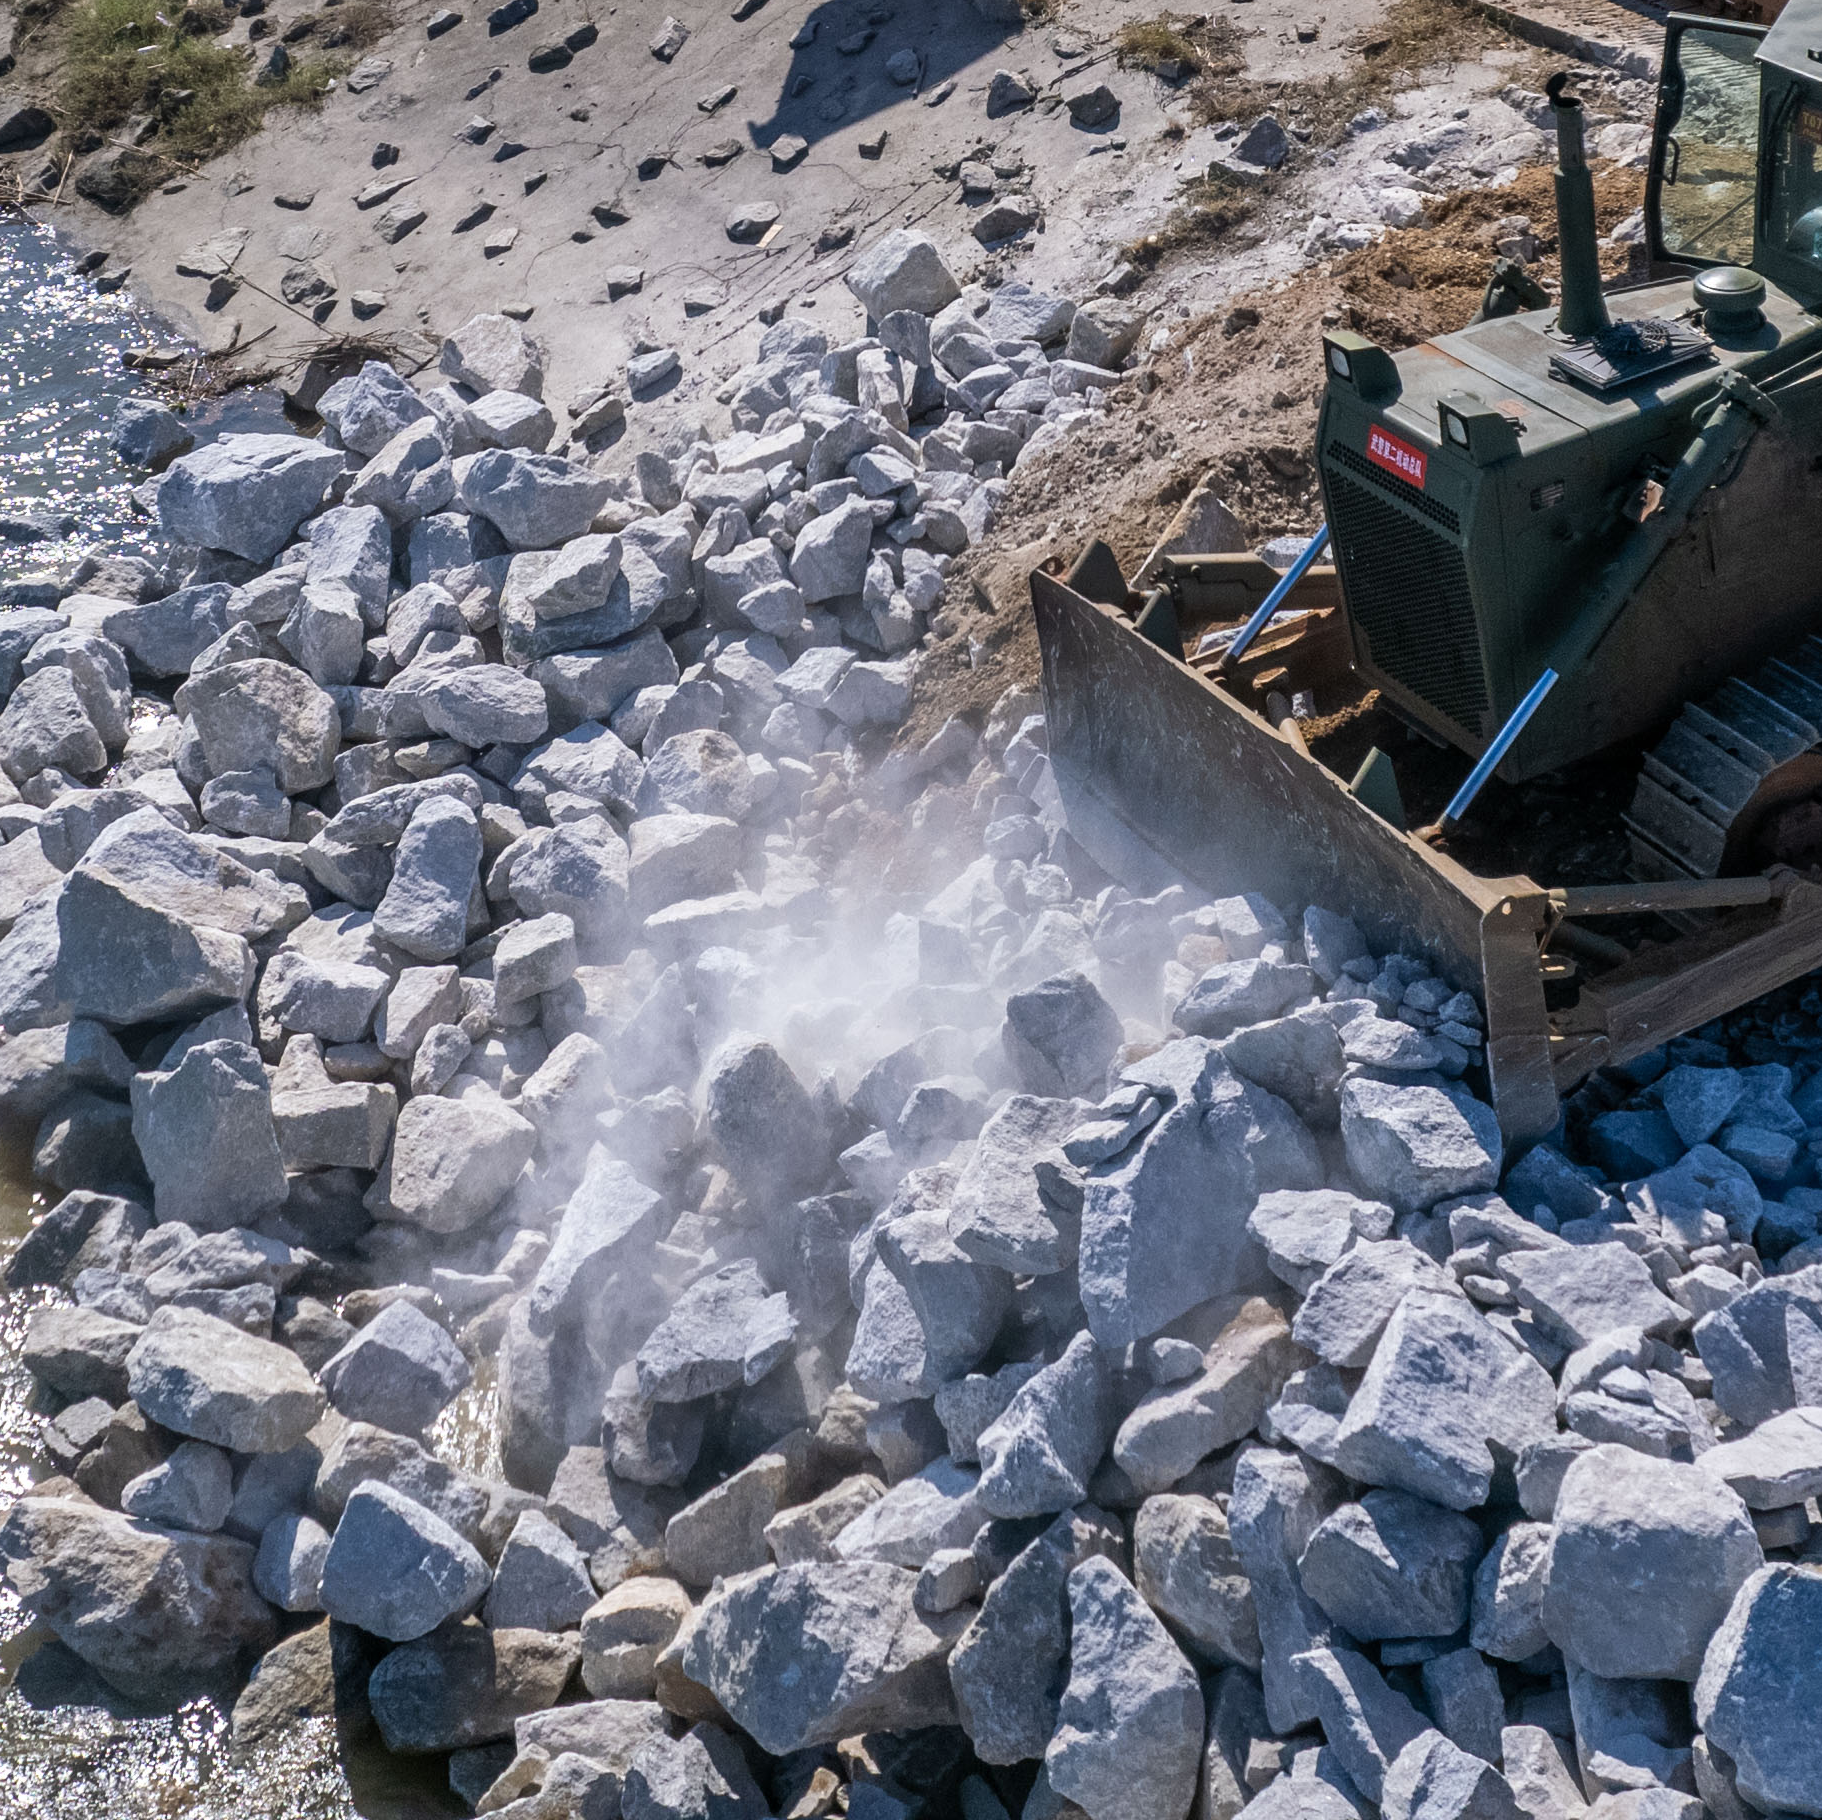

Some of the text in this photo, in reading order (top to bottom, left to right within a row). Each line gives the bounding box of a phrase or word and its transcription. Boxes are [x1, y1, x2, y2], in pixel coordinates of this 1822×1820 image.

[1370, 433, 1422, 479] 武警第二机动总队
